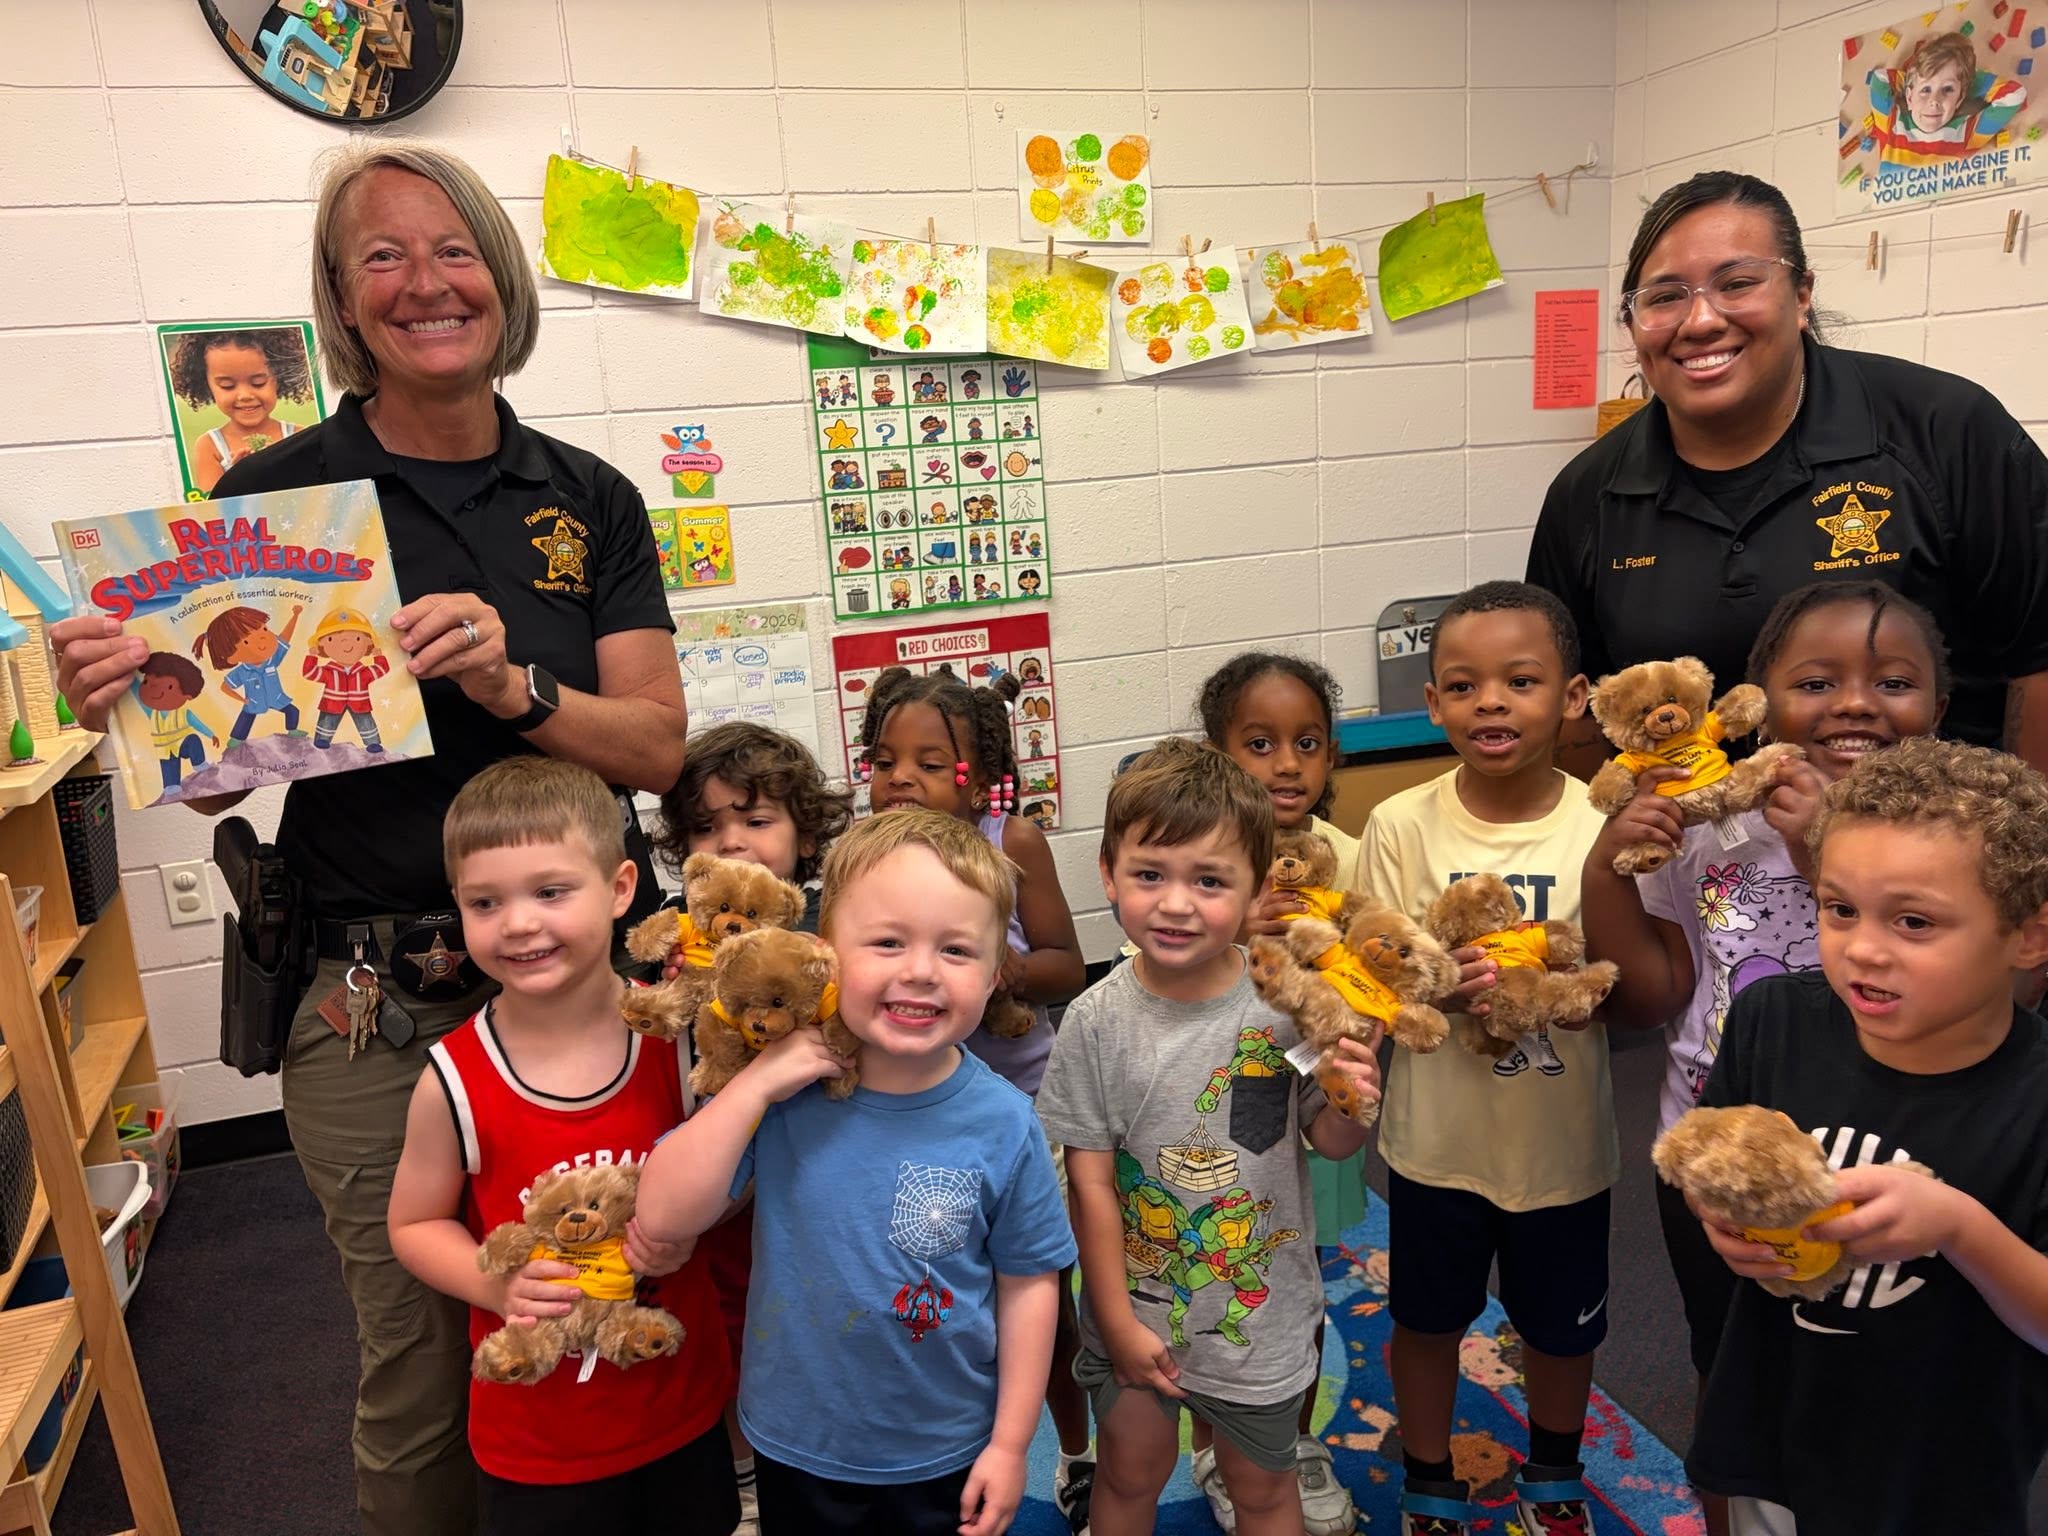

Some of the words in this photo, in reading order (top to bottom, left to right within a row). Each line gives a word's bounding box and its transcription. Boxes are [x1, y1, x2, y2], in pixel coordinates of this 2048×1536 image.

[1067, 162, 1095, 173] Citrus
[1859, 179, 1872, 193] IF
[1874, 171, 1904, 189] YOU
[1907, 165, 1938, 183] CAN
[1943, 150, 2010, 176] IMAGINE
[1082, 175, 1103, 186] Prints
[1873, 185, 1903, 204] YOU
[1907, 180, 1937, 198] CAN
[1942, 171, 1986, 192] MAKE
[1992, 167, 2008, 182] IT.
[1812, 481, 1851, 507] Fairfield
[1856, 481, 1894, 500] County
[524, 507, 559, 527] Fairfield
[561, 510, 589, 537] County
[651, 519, 669, 530] ing
[682, 517, 724, 526] Summer
[76, 533, 96, 545] DK
[169, 517, 276, 554] REAL
[1613, 558, 1623, 569] L.
[1625, 556, 1656, 569] Foster
[1813, 557, 1860, 571] Sheriff's
[1864, 552, 1900, 564] Office
[90, 545, 375, 622] SUPERHEROES
[533, 579, 570, 592] Sheriff's
[170, 615, 178, 624] A
[178, 597, 224, 619] celebration
[225, 591, 235, 601] of
[237, 588, 277, 599] essential
[279, 590, 314, 603] workers
[761, 614, 797, 629] 2026
[909, 641, 928, 655] RED
[932, 635, 977, 652] CHOICES
[1404, 626, 1432, 652] ye
[738, 675, 747, 683] 10
[252, 768, 263, 776] By
